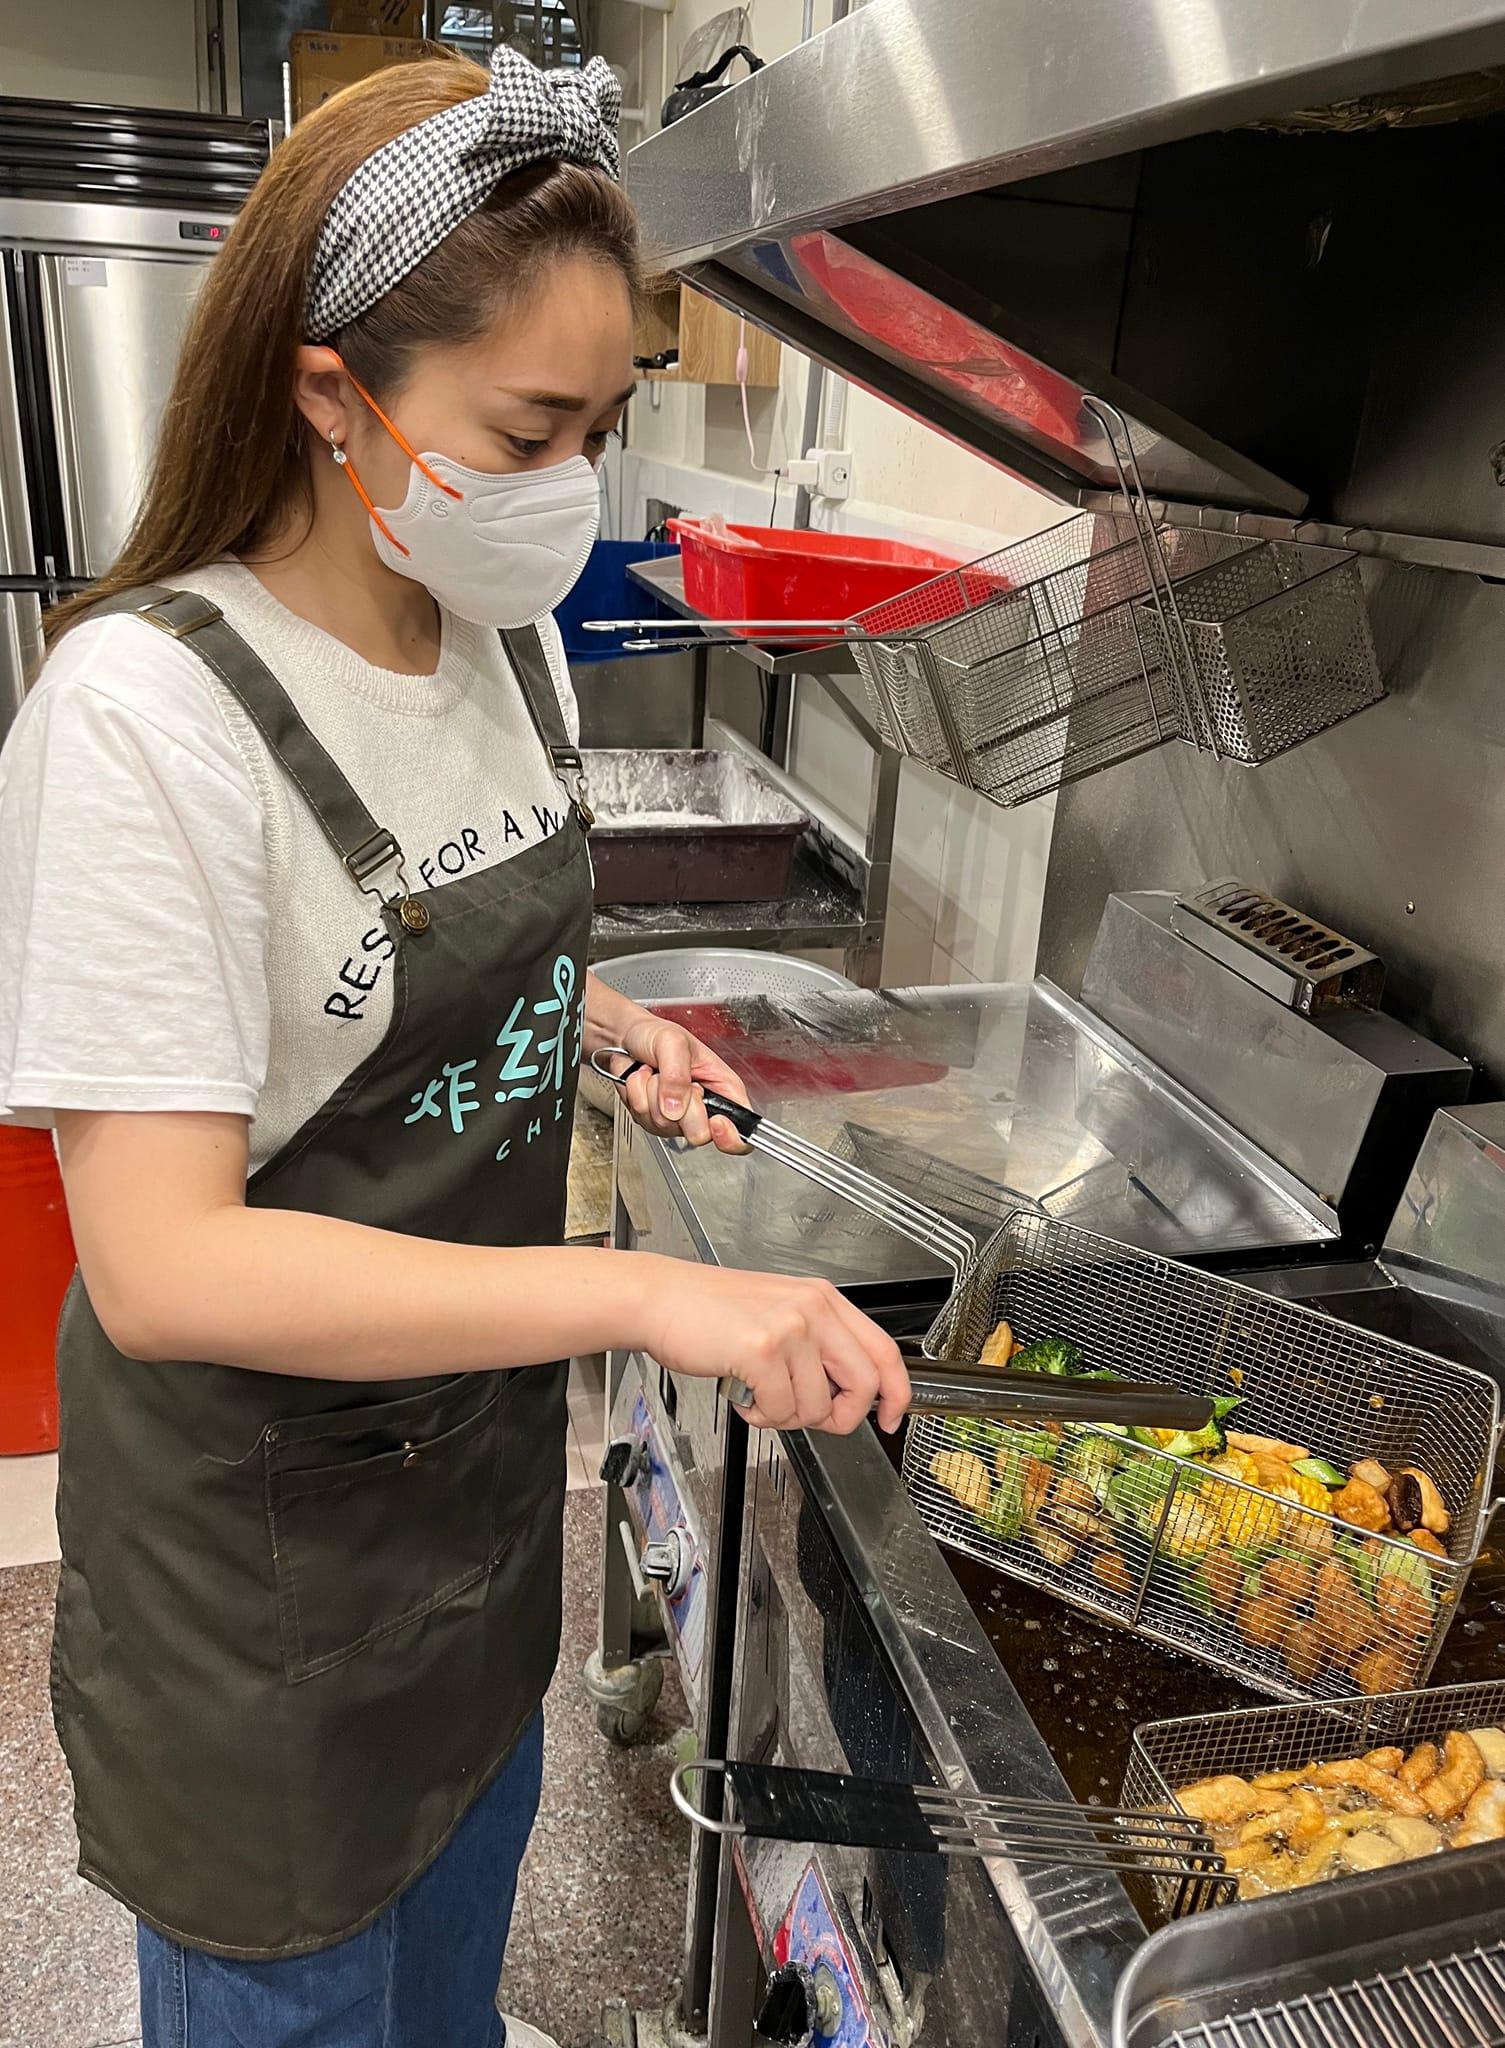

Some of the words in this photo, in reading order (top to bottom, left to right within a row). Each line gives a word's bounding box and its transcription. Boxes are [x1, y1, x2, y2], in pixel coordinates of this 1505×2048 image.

[324, 893, 399, 1020] RES
[418, 828, 486, 888] FOR
[502, 810, 524, 842] A
